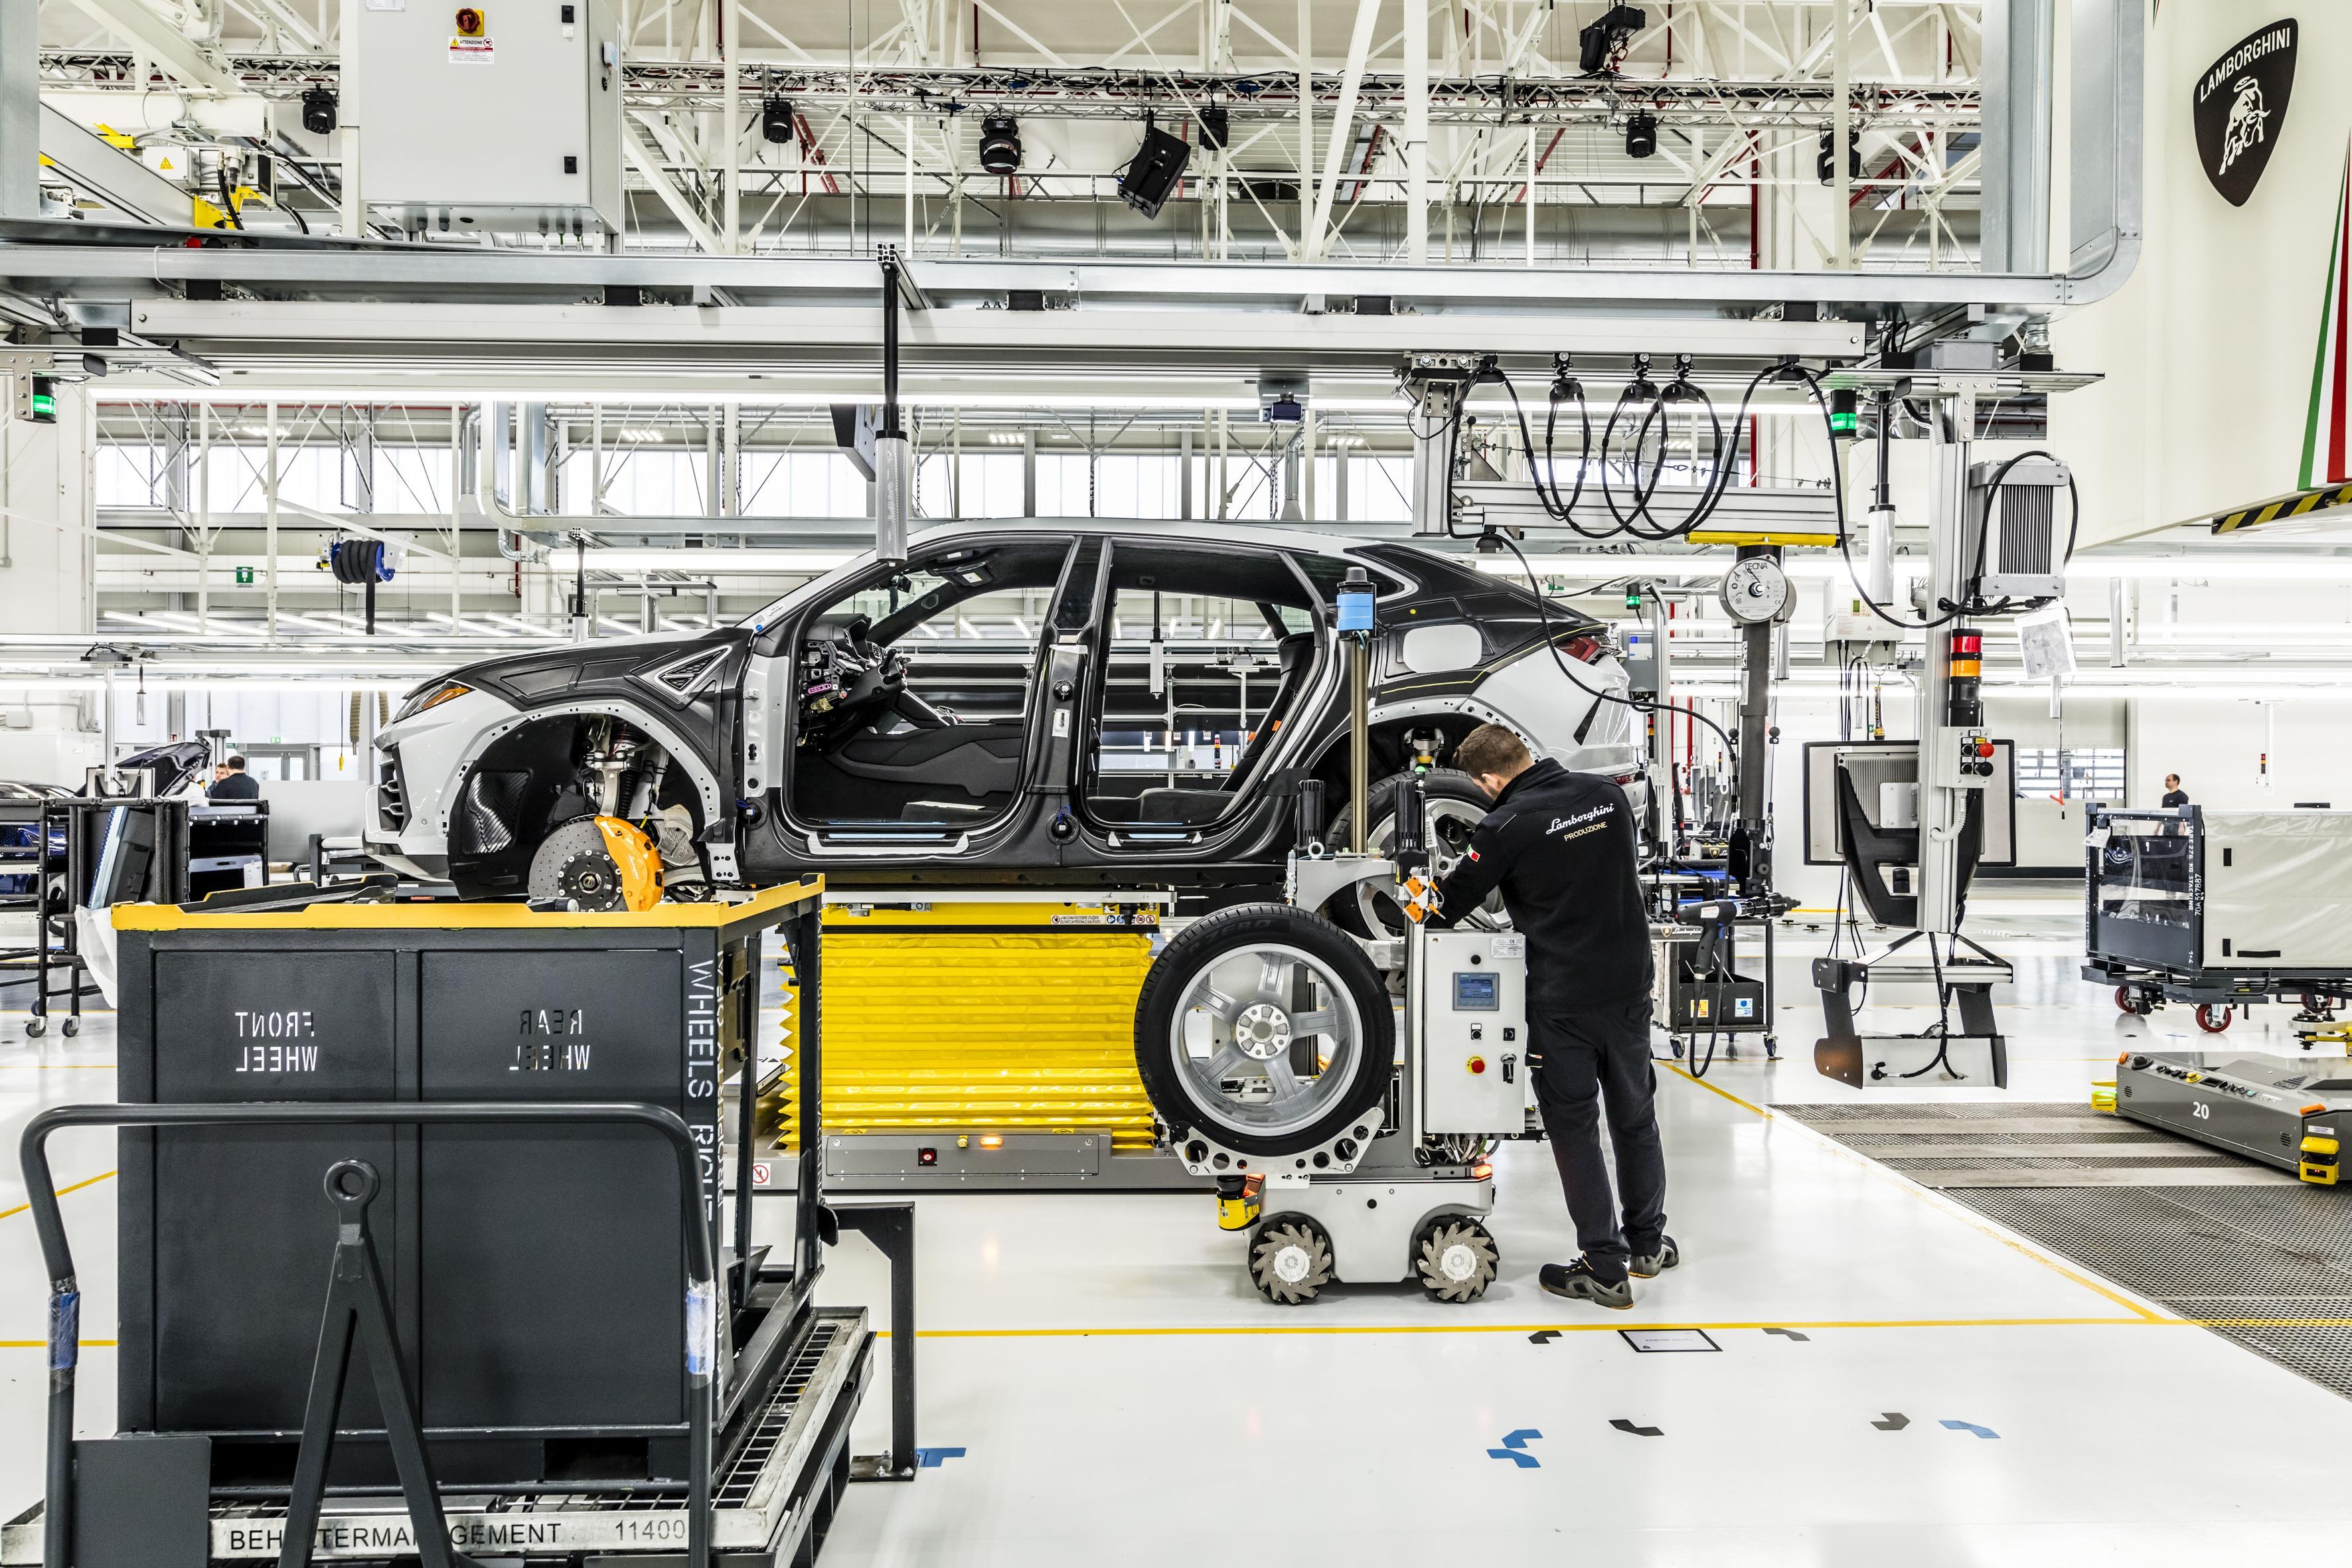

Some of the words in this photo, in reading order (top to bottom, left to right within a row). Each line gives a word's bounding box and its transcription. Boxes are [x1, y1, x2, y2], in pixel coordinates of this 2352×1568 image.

[2200, 27, 2290, 104] LAMBORGHINI
[1545, 803, 1614, 834] Lamborghini
[1564, 822, 1608, 841] PRODUZIONE
[2189, 863, 2194, 873] KG
[688, 959, 714, 1098] WHEELS
[2193, 1101, 2209, 1120] 20
[230, 1524, 561, 1550] BEHTERMAGEMENT
